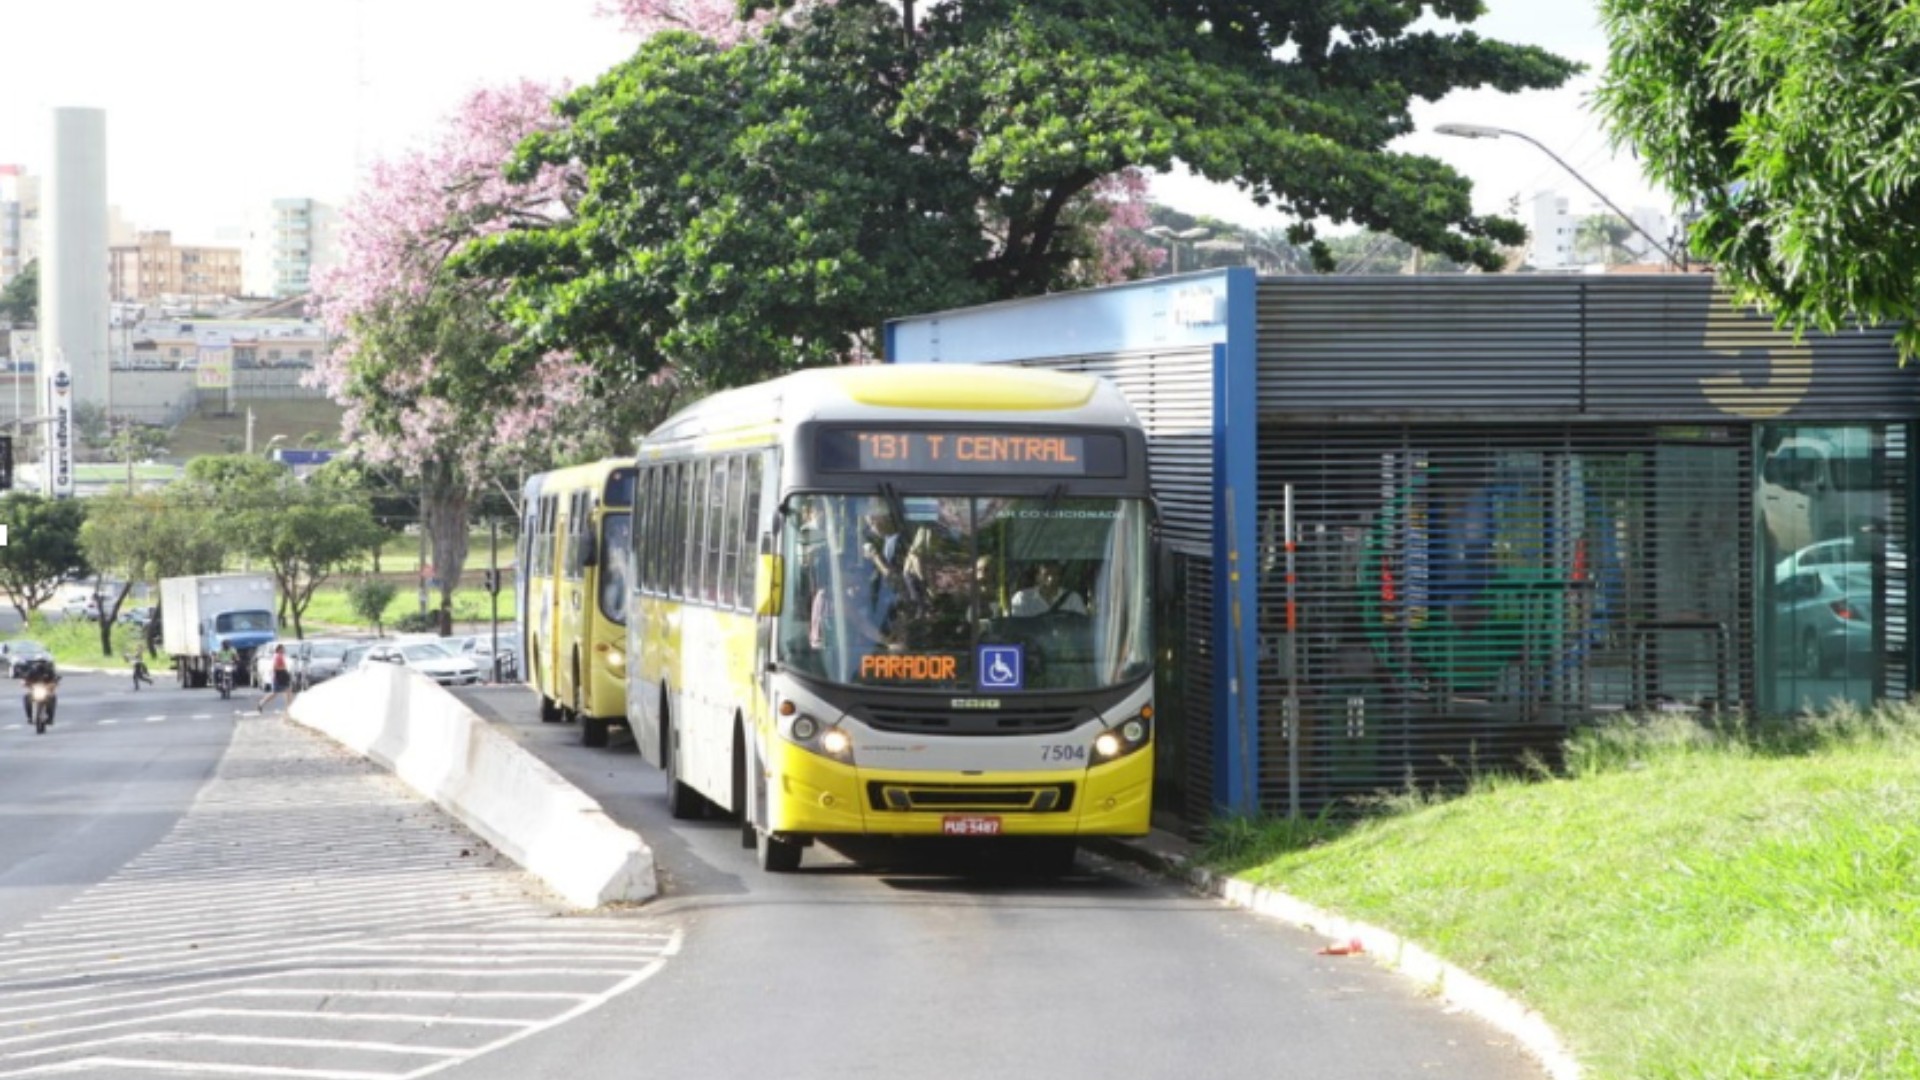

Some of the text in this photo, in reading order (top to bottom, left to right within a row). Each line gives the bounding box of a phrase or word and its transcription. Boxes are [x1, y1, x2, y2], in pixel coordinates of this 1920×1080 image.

[1699, 275, 1813, 418] 5
[926, 435, 944, 460] T
[956, 436, 1077, 462] CENTRAL
[862, 654, 956, 679] PARADOR
[1041, 744, 1084, 761] 7504
